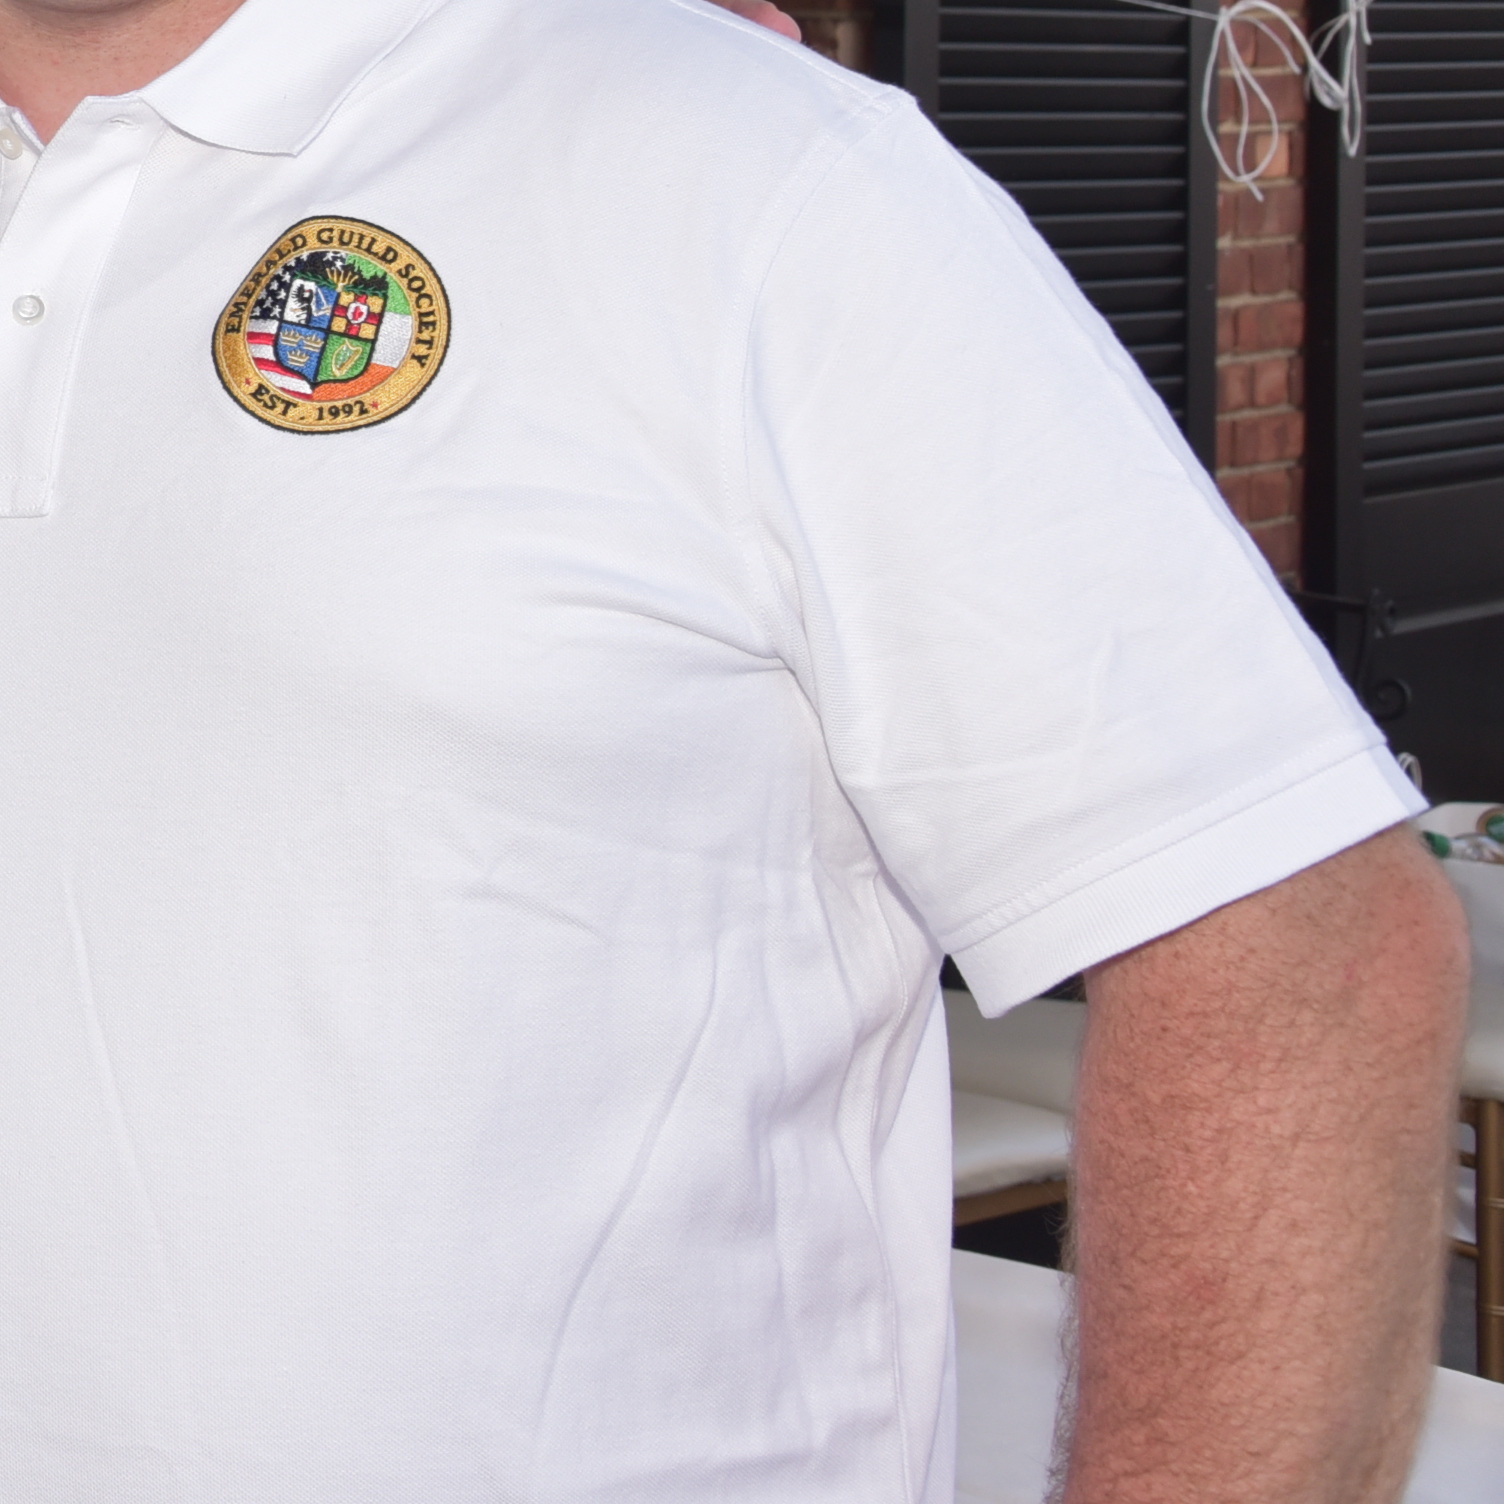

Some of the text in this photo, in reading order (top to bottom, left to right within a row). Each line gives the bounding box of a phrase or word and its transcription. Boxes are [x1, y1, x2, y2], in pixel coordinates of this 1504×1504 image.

[225, 227, 437, 368] EMERALD GUILD SOCIETY
[316, 400, 369, 422] 1992
